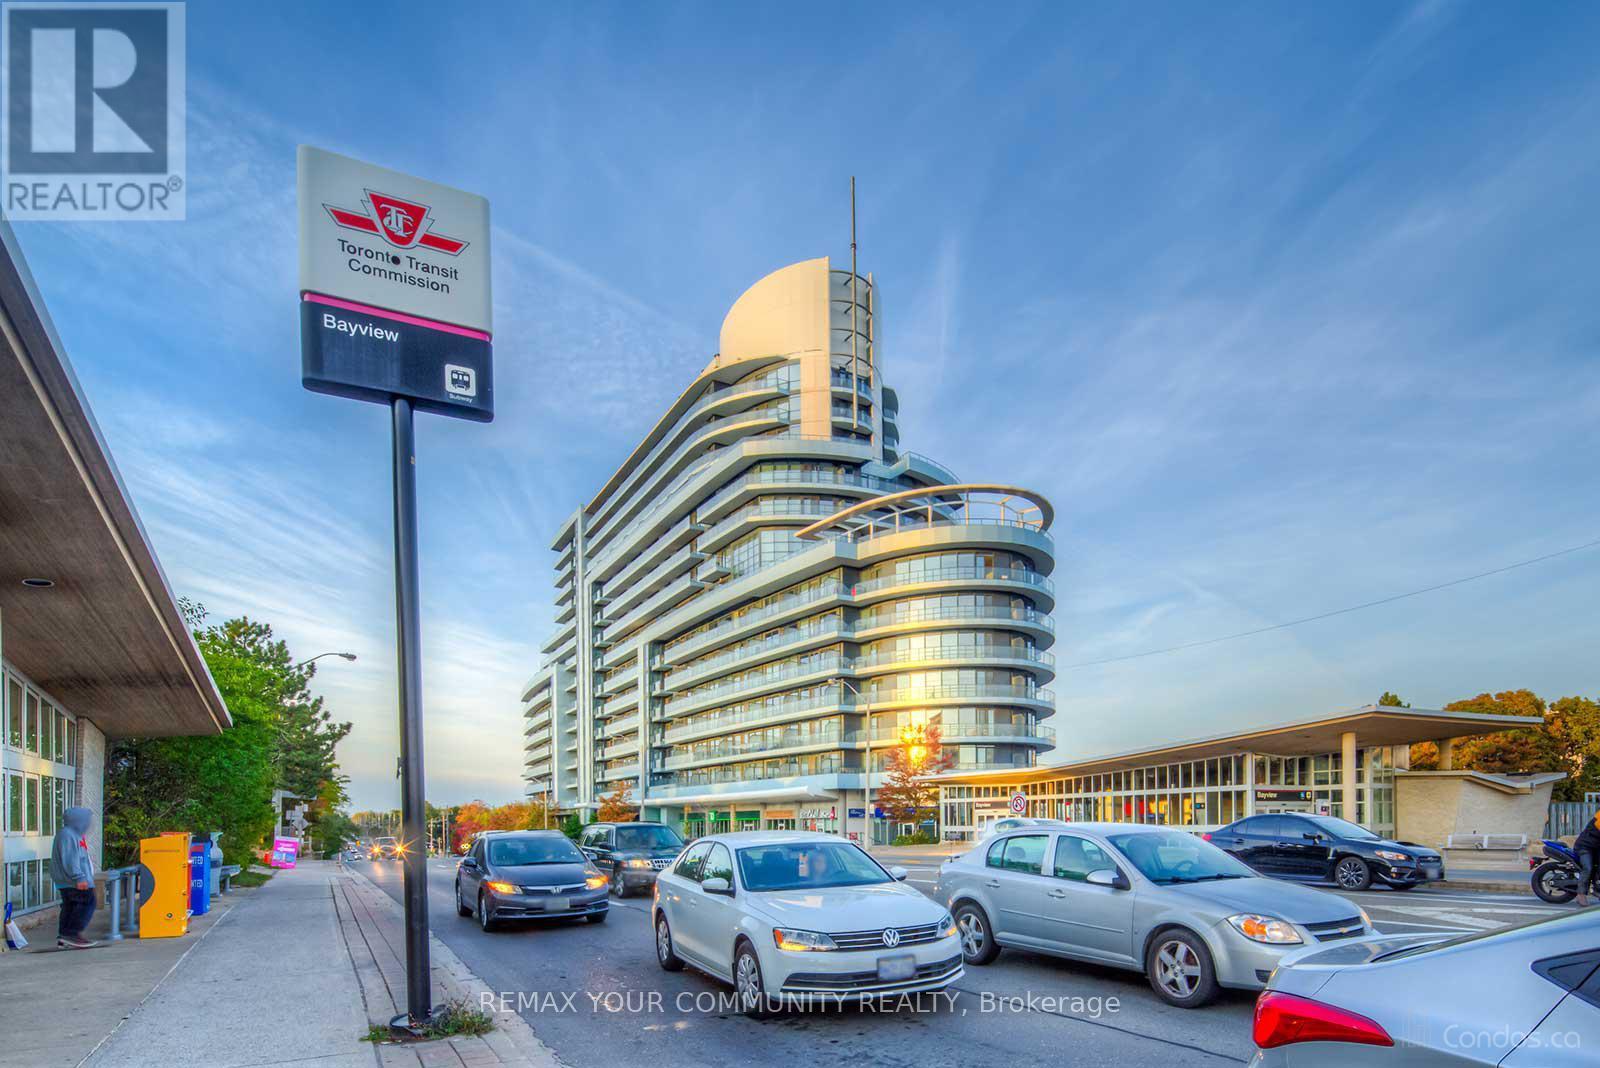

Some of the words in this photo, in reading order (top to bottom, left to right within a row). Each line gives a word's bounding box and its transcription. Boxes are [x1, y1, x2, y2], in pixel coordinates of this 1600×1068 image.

[337, 238, 400, 265] Toronto
[406, 255, 459, 280] Transit
[348, 258, 450, 294] Commission
[323, 313, 399, 342] Bayview
